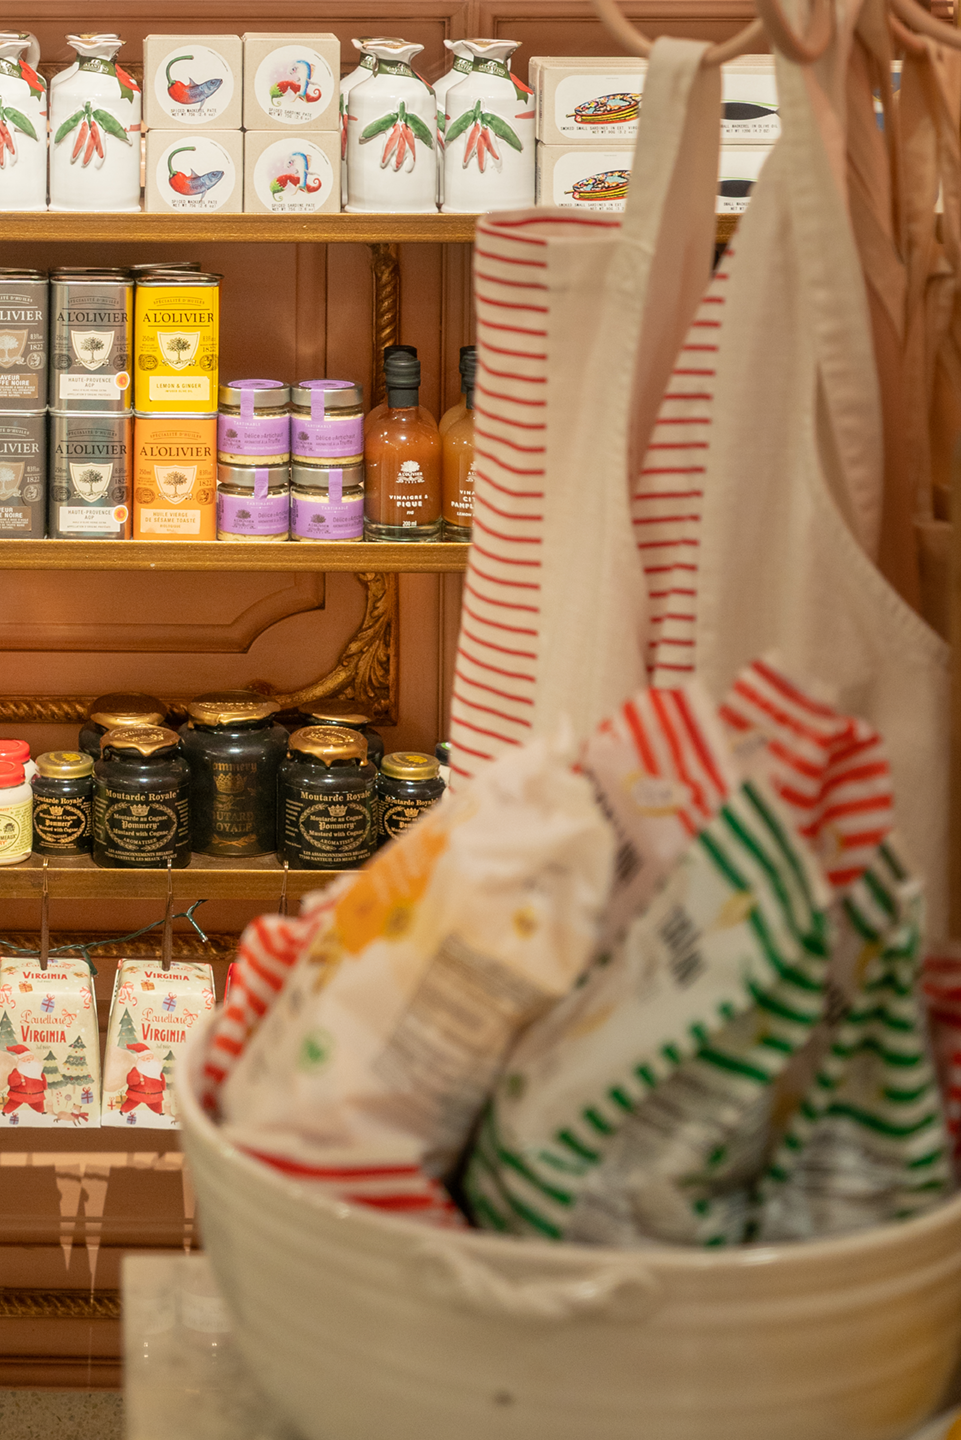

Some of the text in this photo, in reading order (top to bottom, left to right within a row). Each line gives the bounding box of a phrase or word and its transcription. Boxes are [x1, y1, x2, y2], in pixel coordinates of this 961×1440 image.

[68, 312, 128, 322] L'OLIVIER
[154, 312, 214, 323] L'OLIVIER
[66, 444, 127, 455] L'OLIVIER
[151, 446, 211, 456] L'OLIVIER
[105, 789, 176, 802] Moutarde Royale
[301, 791, 371, 801] Moutarde Royale
[122, 820, 158, 829] Pommery
[318, 822, 354, 830] Pommery
[23, 971, 68, 981] VIRGINIA
[144, 971, 190, 981] VIRGINIA
[21, 1025, 67, 1043] VIRGINIA
[141, 1023, 186, 1043] VIRGINIA
